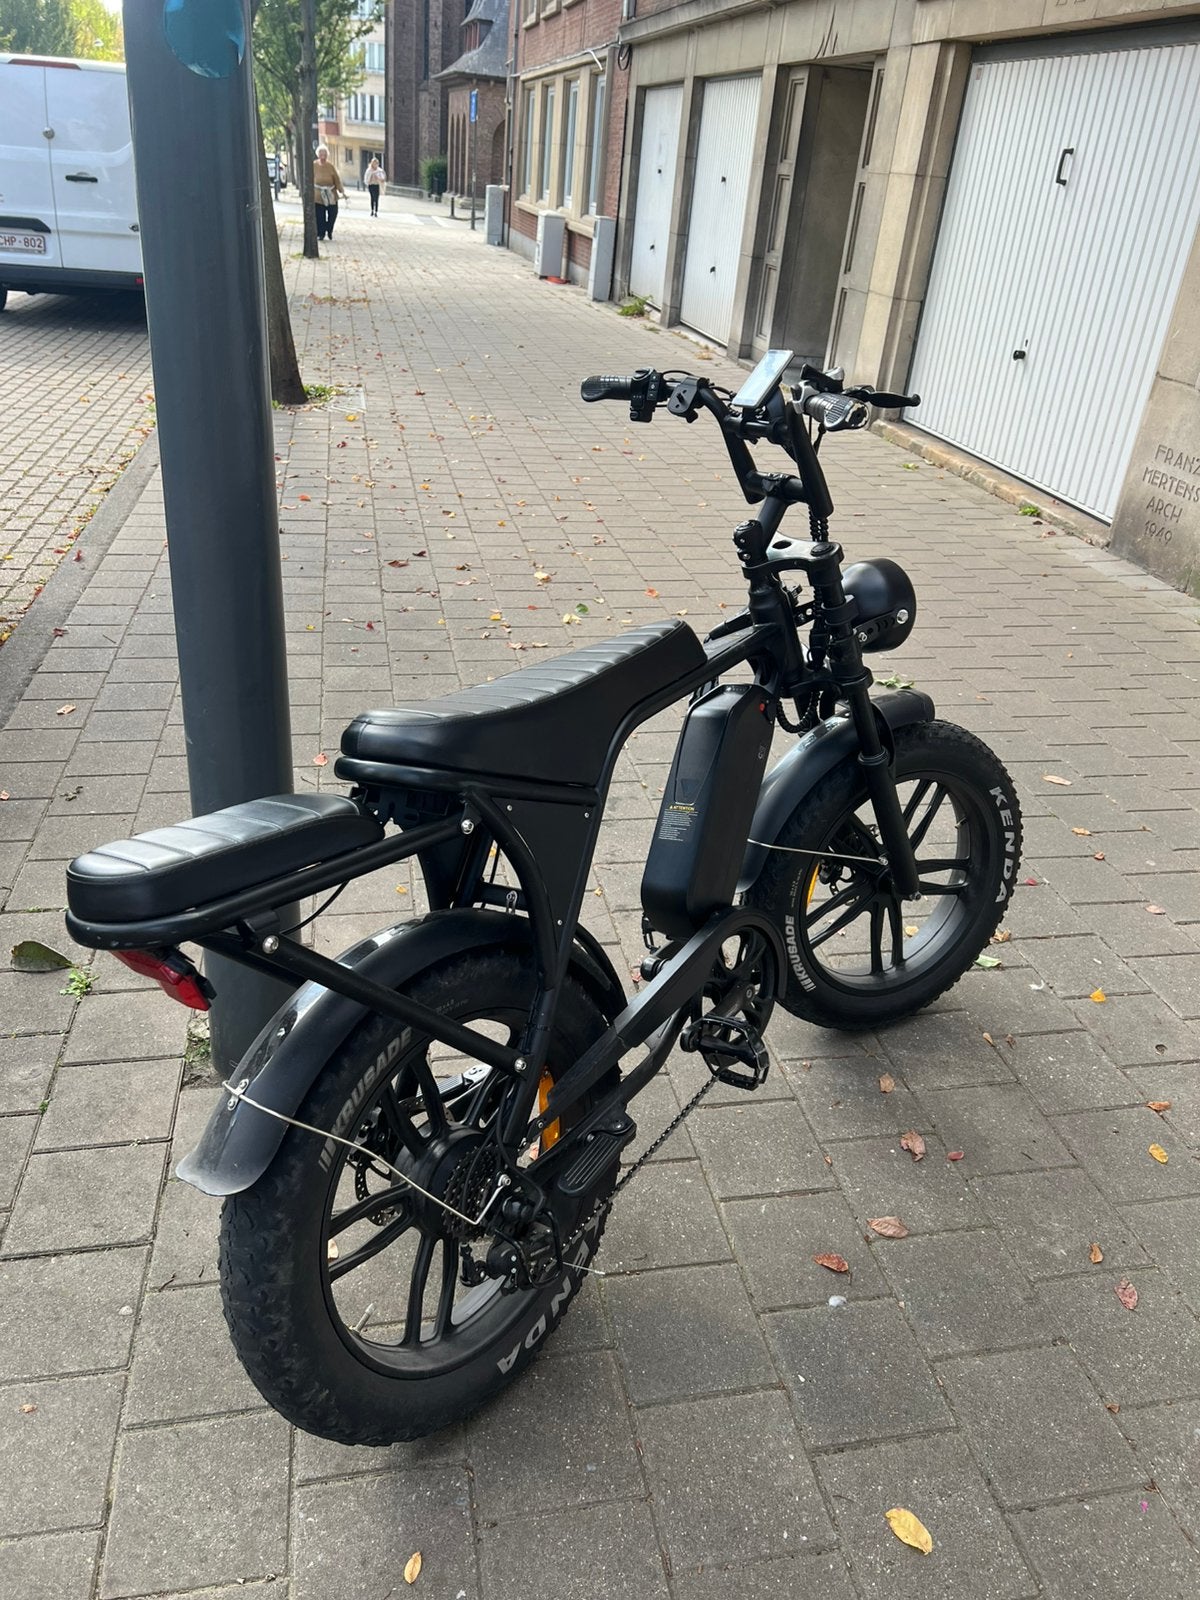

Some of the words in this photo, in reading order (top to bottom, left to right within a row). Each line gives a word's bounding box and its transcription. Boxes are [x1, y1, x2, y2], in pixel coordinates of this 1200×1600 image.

[1142, 467, 1200, 503] MERTENS
[1146, 496, 1183, 523] ARCH
[1145, 520, 1173, 545] 1949
[989, 786, 1015, 902] KENDA
